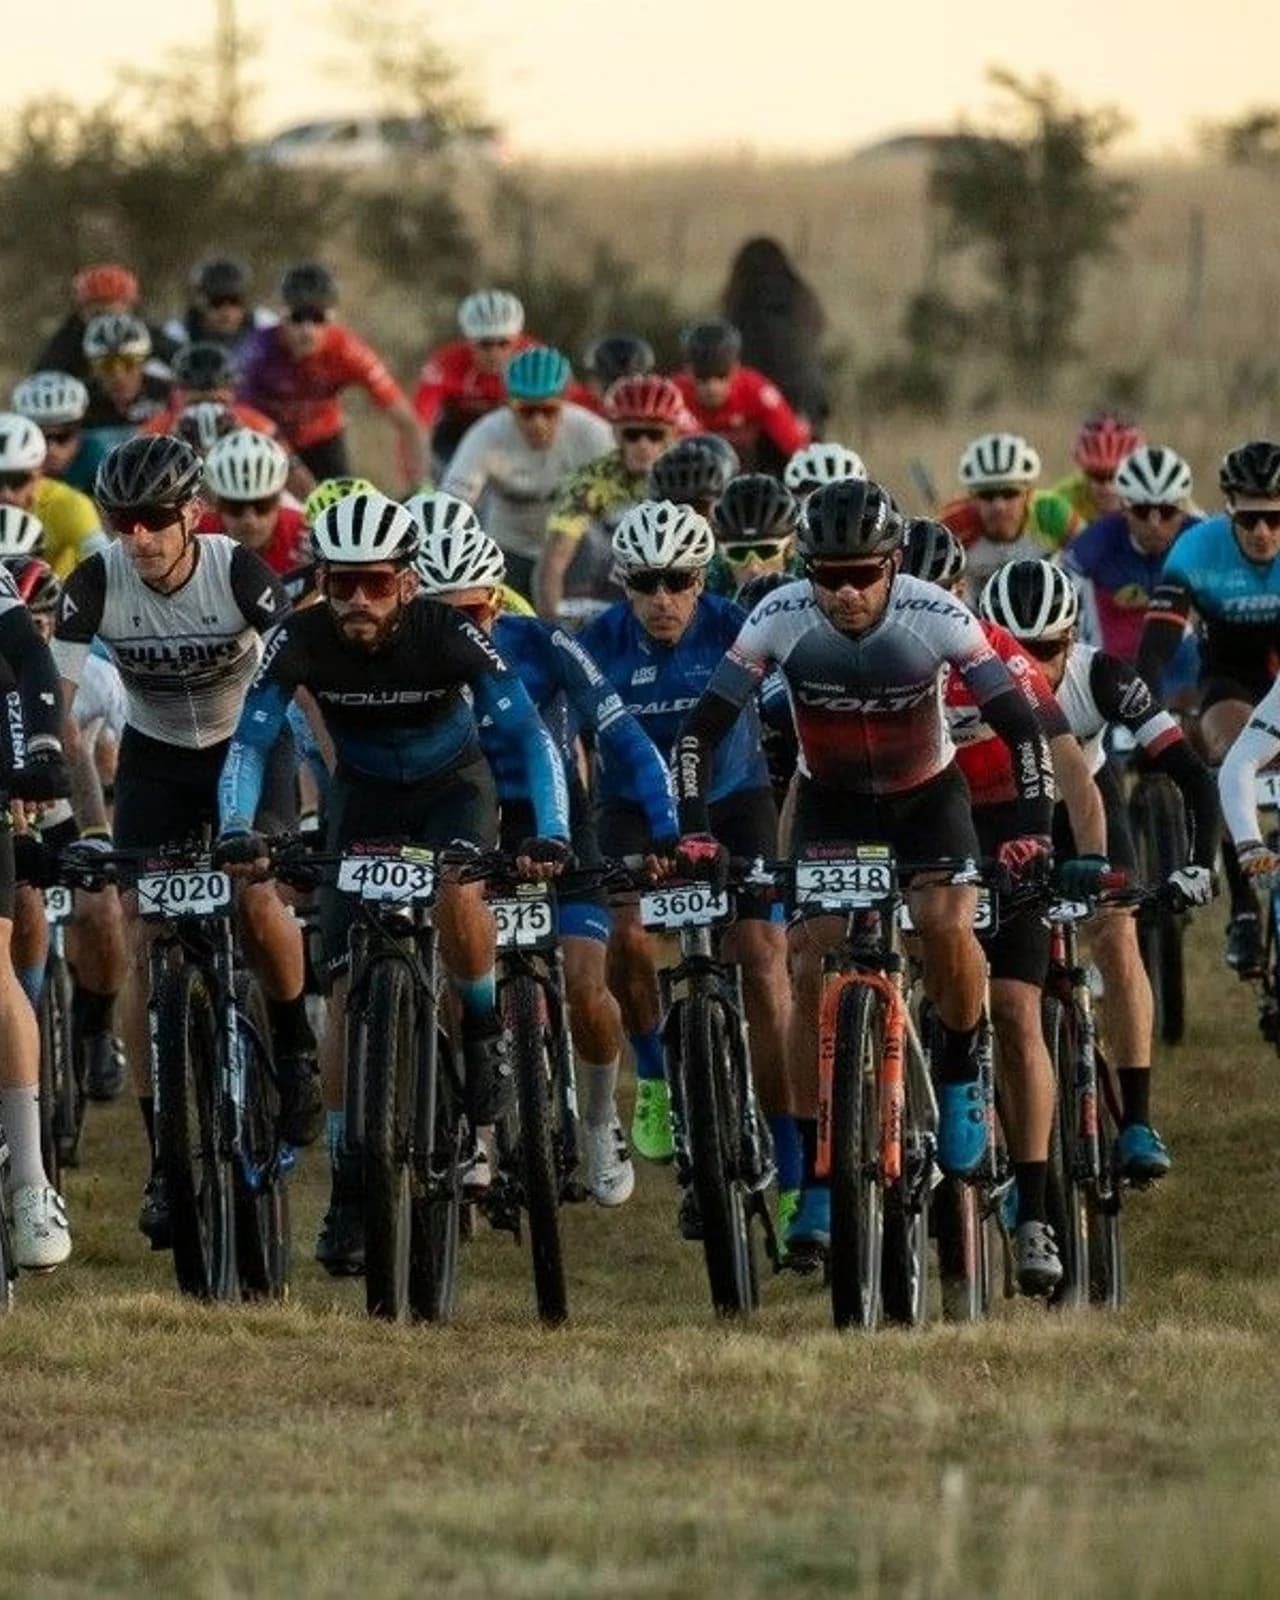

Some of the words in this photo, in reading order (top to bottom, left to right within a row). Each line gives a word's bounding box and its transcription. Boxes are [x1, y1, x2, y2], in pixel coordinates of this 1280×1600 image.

[626, 697, 700, 715] RALEI
[151, 873, 223, 903] 2020
[351, 862, 428, 890] 4003
[810, 867, 884, 893] 3318
[652, 891, 723, 918] 3604
